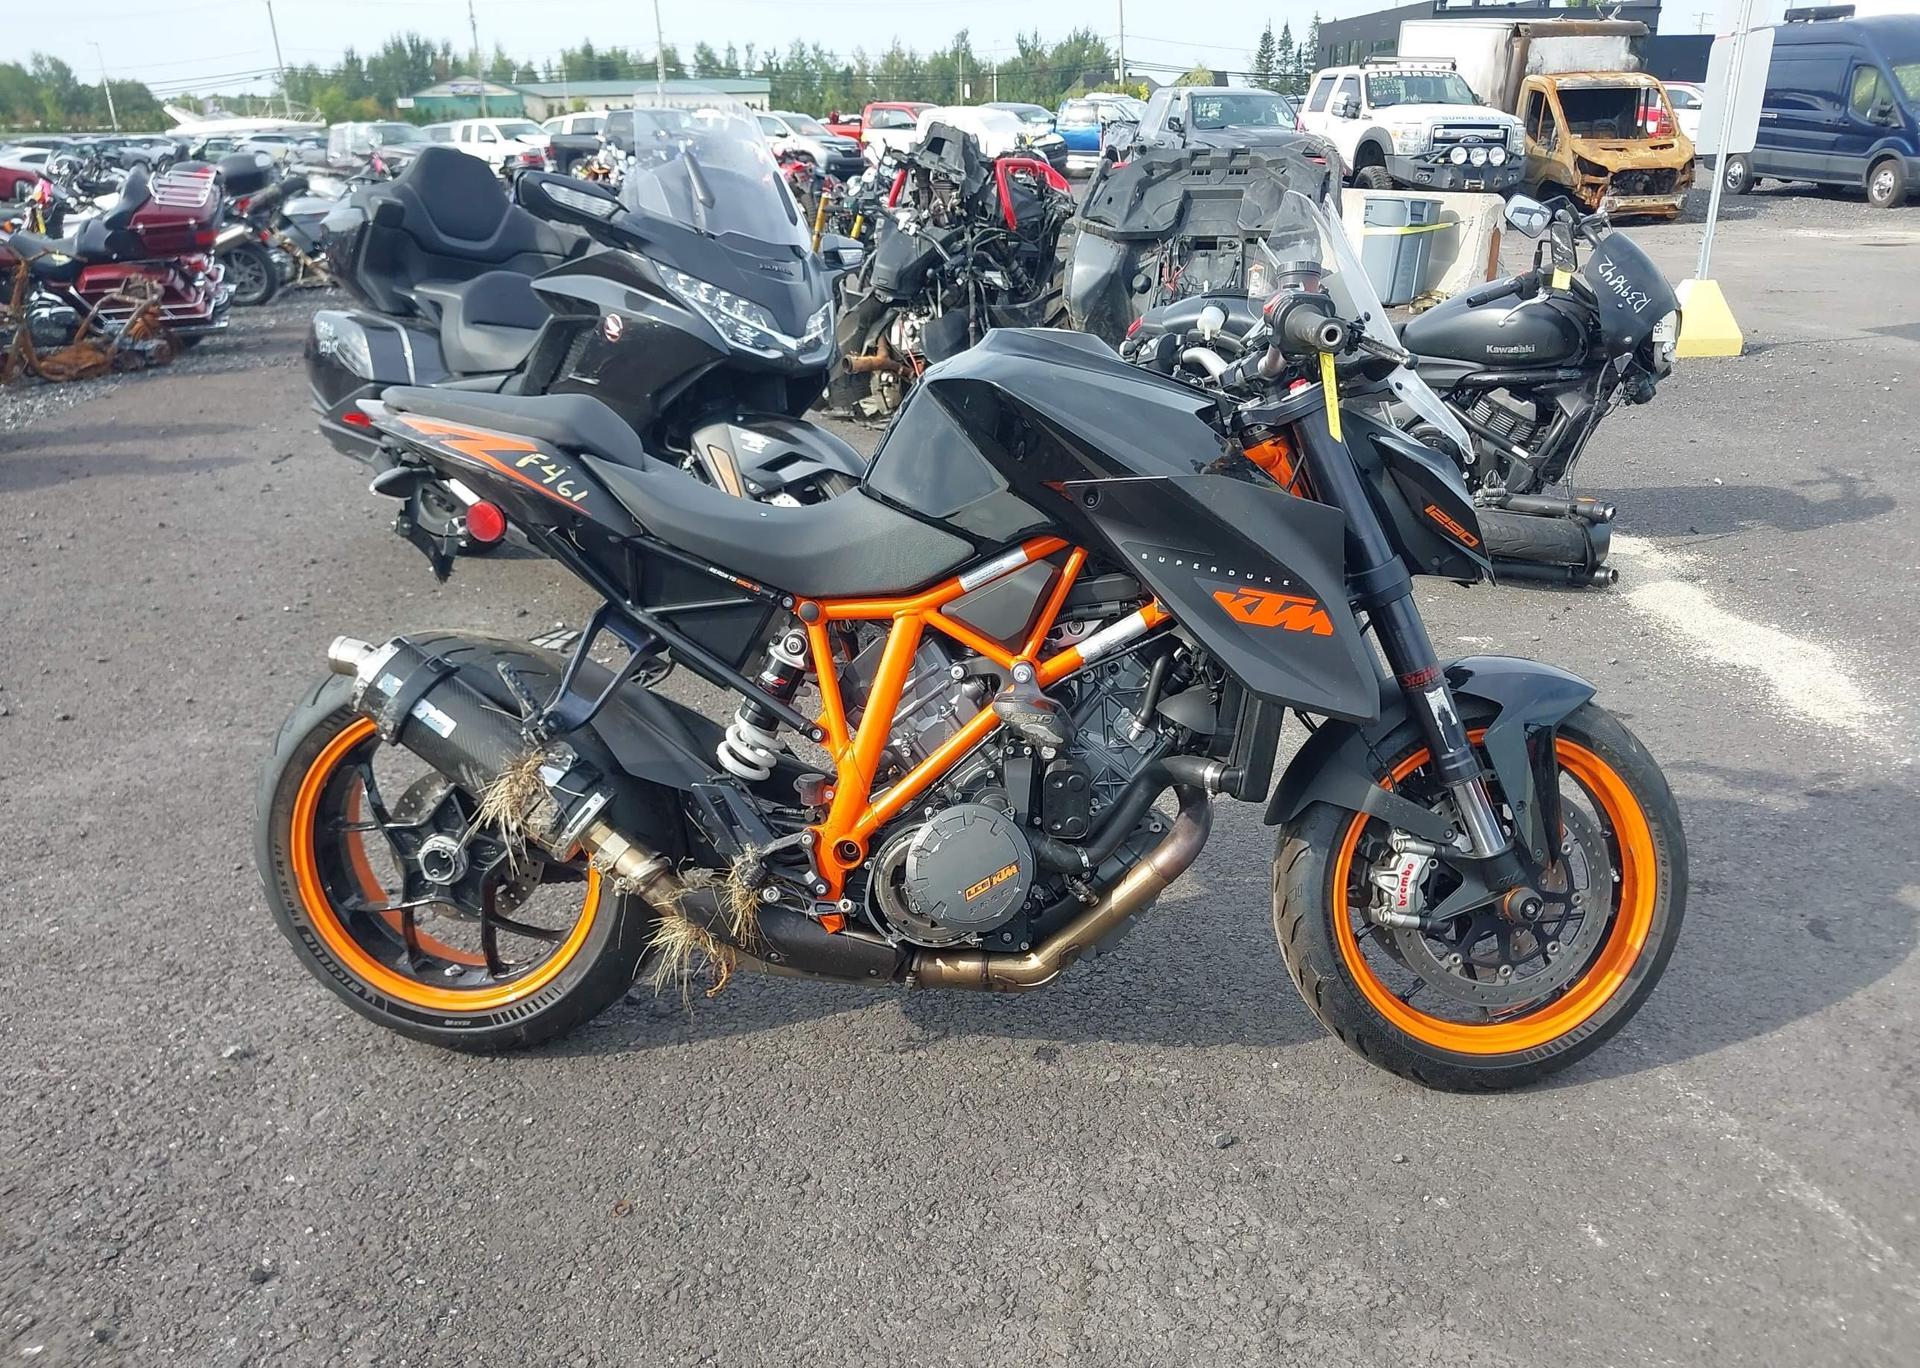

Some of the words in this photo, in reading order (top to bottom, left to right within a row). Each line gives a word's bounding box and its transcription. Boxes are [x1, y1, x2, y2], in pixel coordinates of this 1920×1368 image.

[1486, 344, 1536, 353] Kawasaki
[1424, 504, 1480, 547] 1290
[1213, 587, 1334, 636] KTM
[1398, 863, 1414, 906] brembo
[302, 932, 364, 996] MICHELIN
